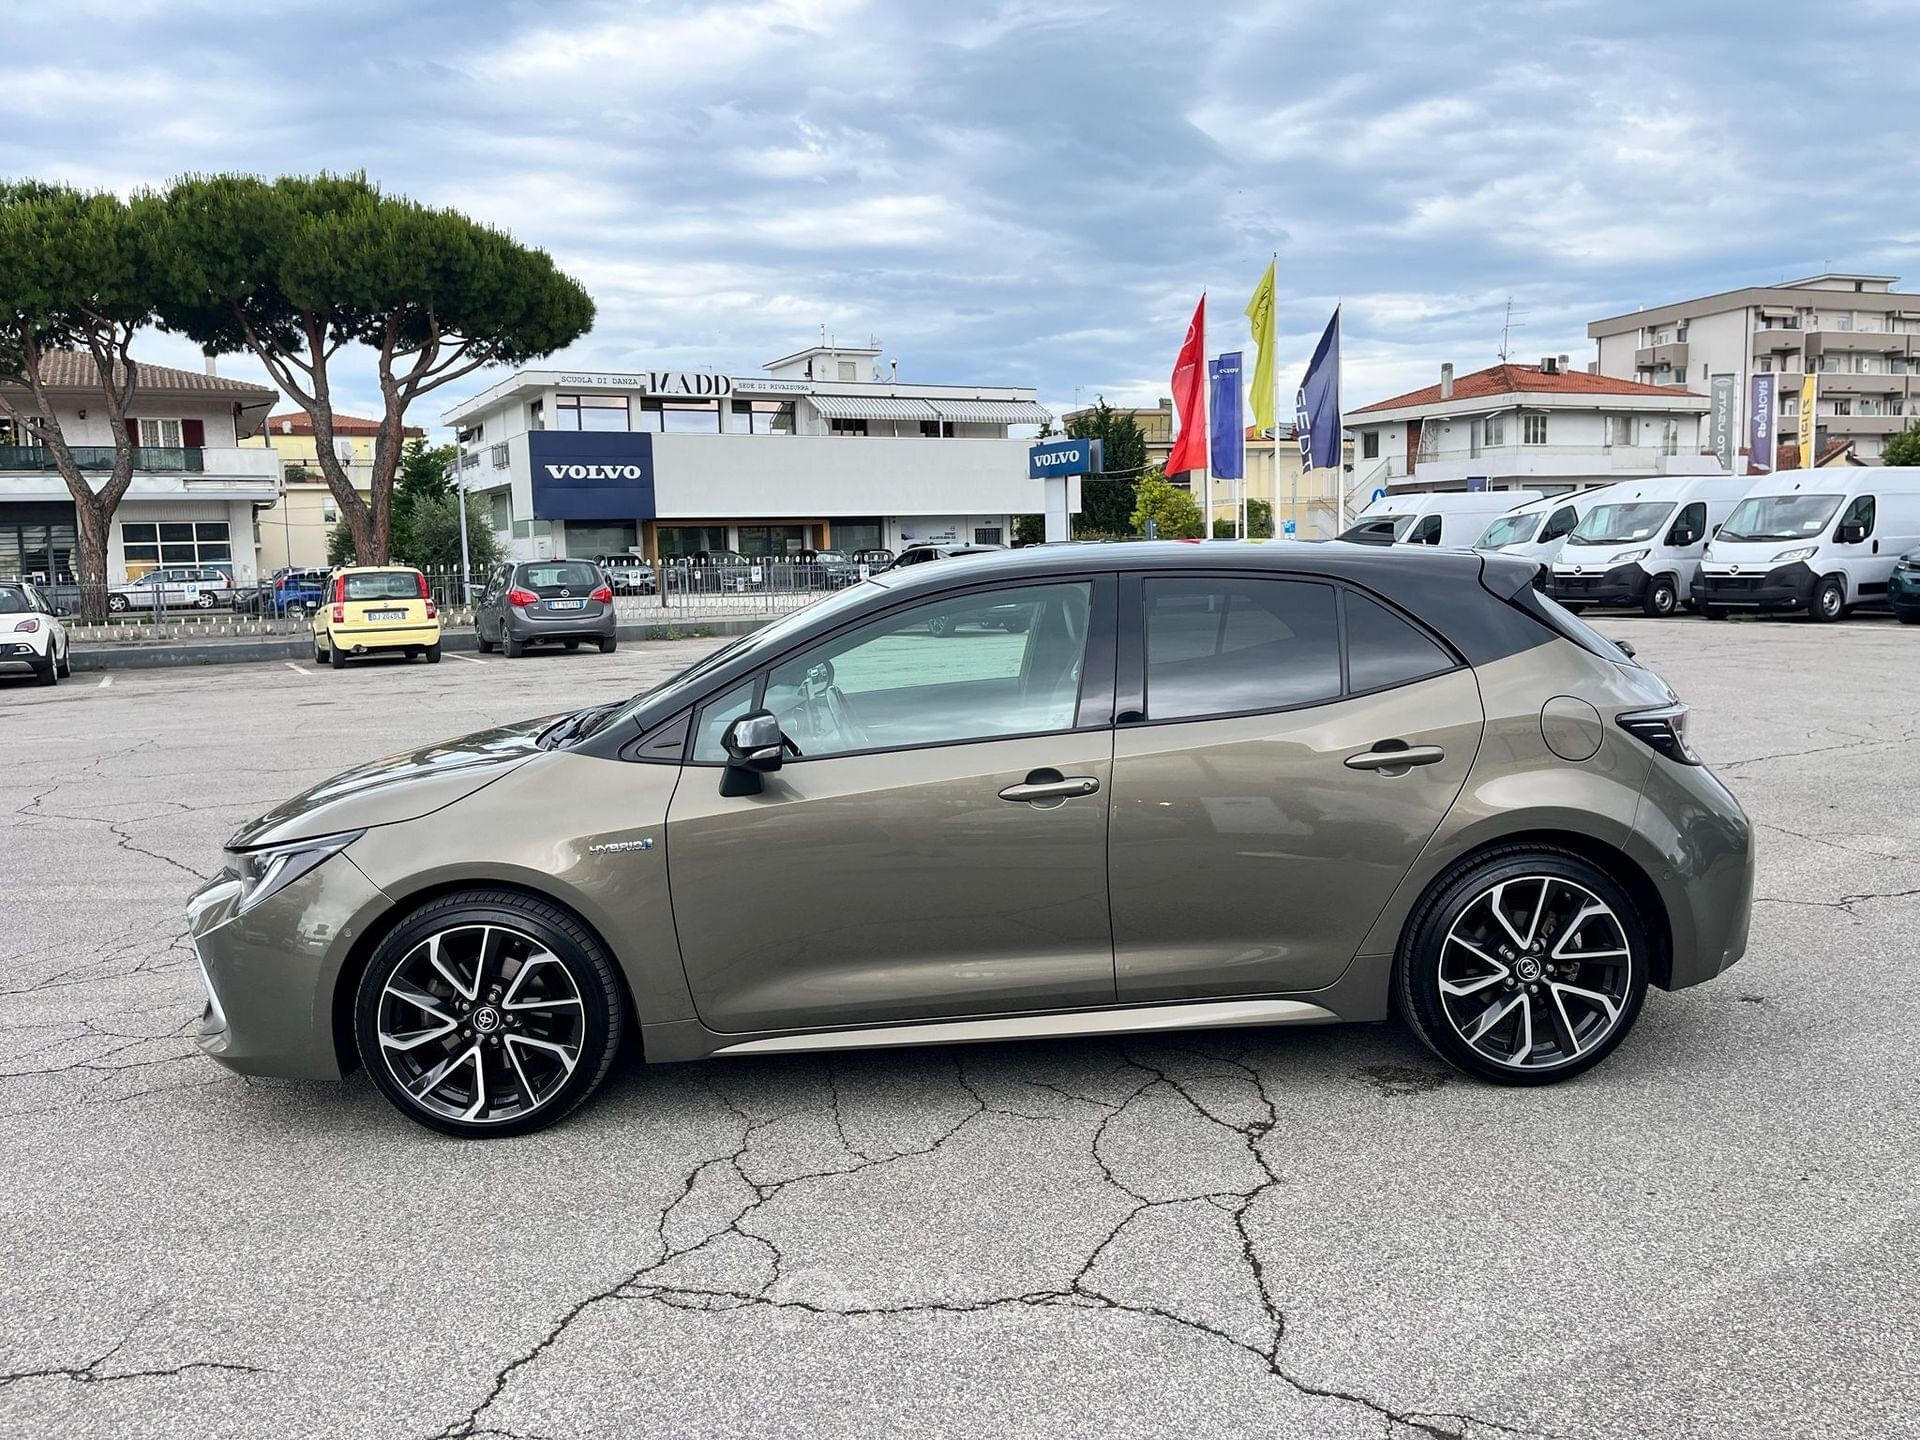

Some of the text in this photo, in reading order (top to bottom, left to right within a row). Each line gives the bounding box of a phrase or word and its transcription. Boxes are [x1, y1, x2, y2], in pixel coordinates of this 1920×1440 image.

[561, 375, 639, 385] SCUOLA DI DANZA
[1033, 449, 1080, 468] VOLVO
[544, 464, 641, 480] VOLVO
[589, 841, 643, 855] HYBRID
